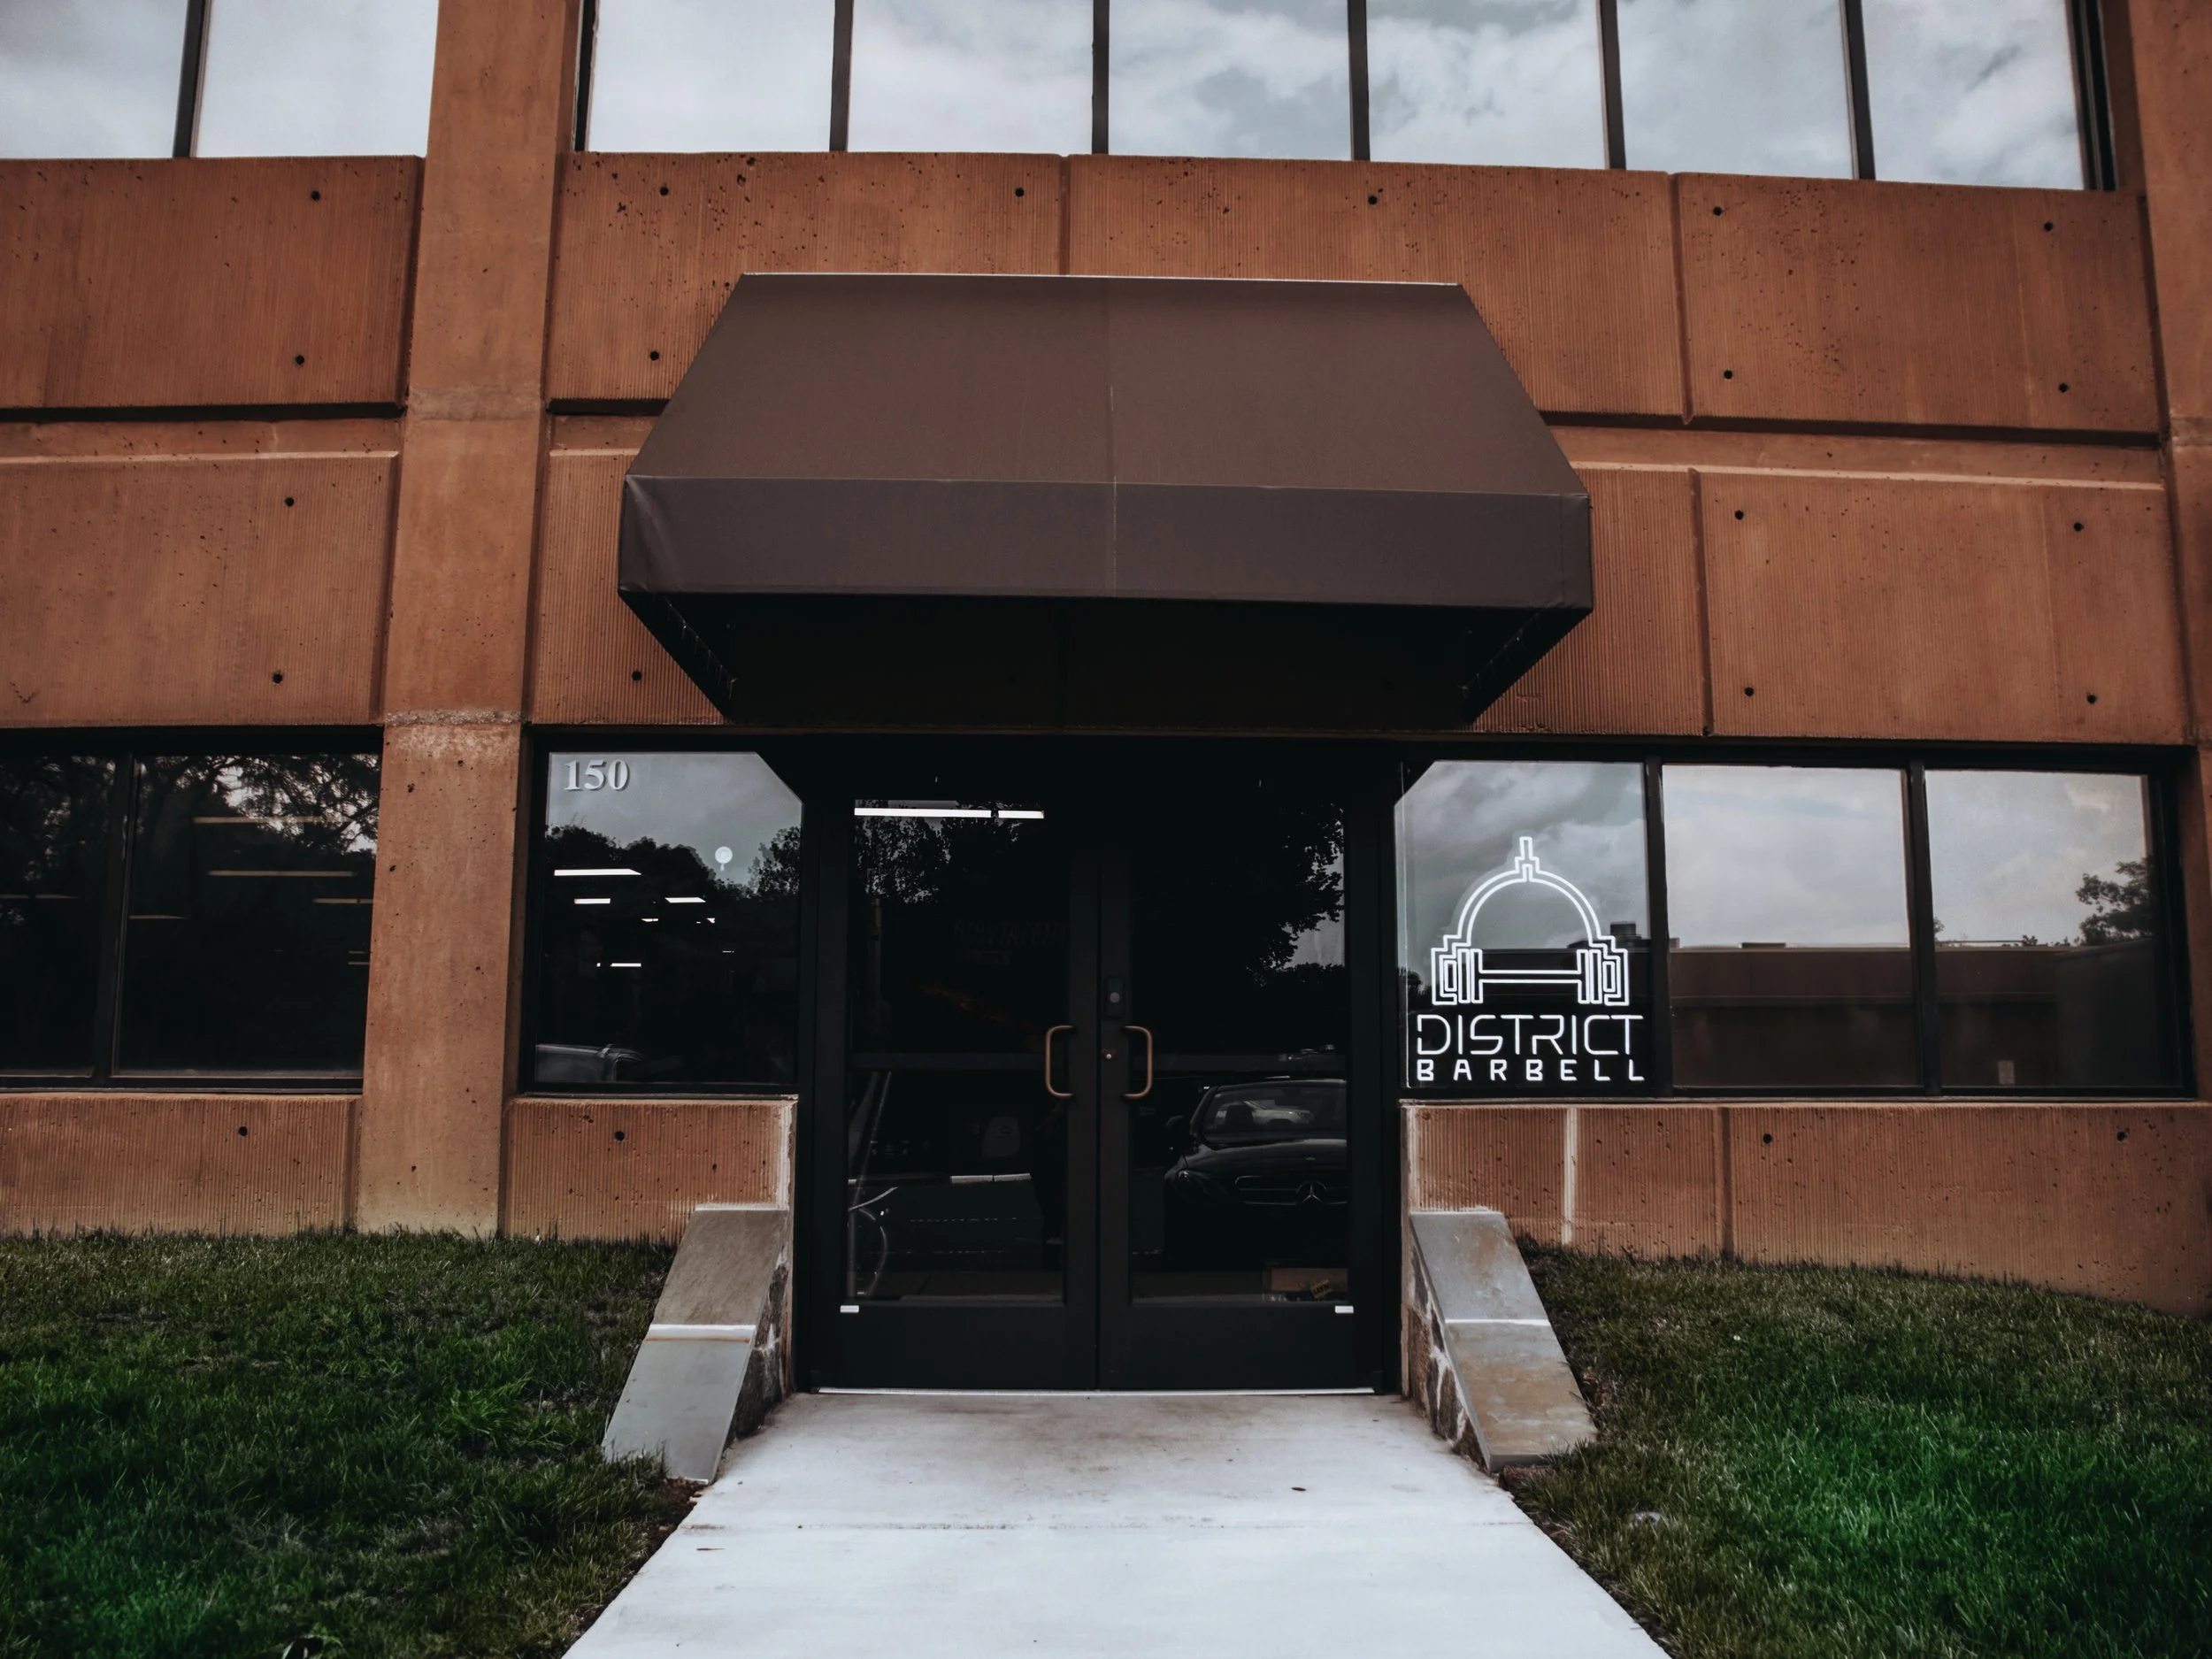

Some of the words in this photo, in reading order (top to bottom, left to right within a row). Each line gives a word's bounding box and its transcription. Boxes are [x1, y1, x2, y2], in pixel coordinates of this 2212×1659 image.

[564, 759, 629, 791] 150
[1417, 1014, 1644, 1056] DISTRICT
[1417, 1059, 1645, 1081] BARBELL
